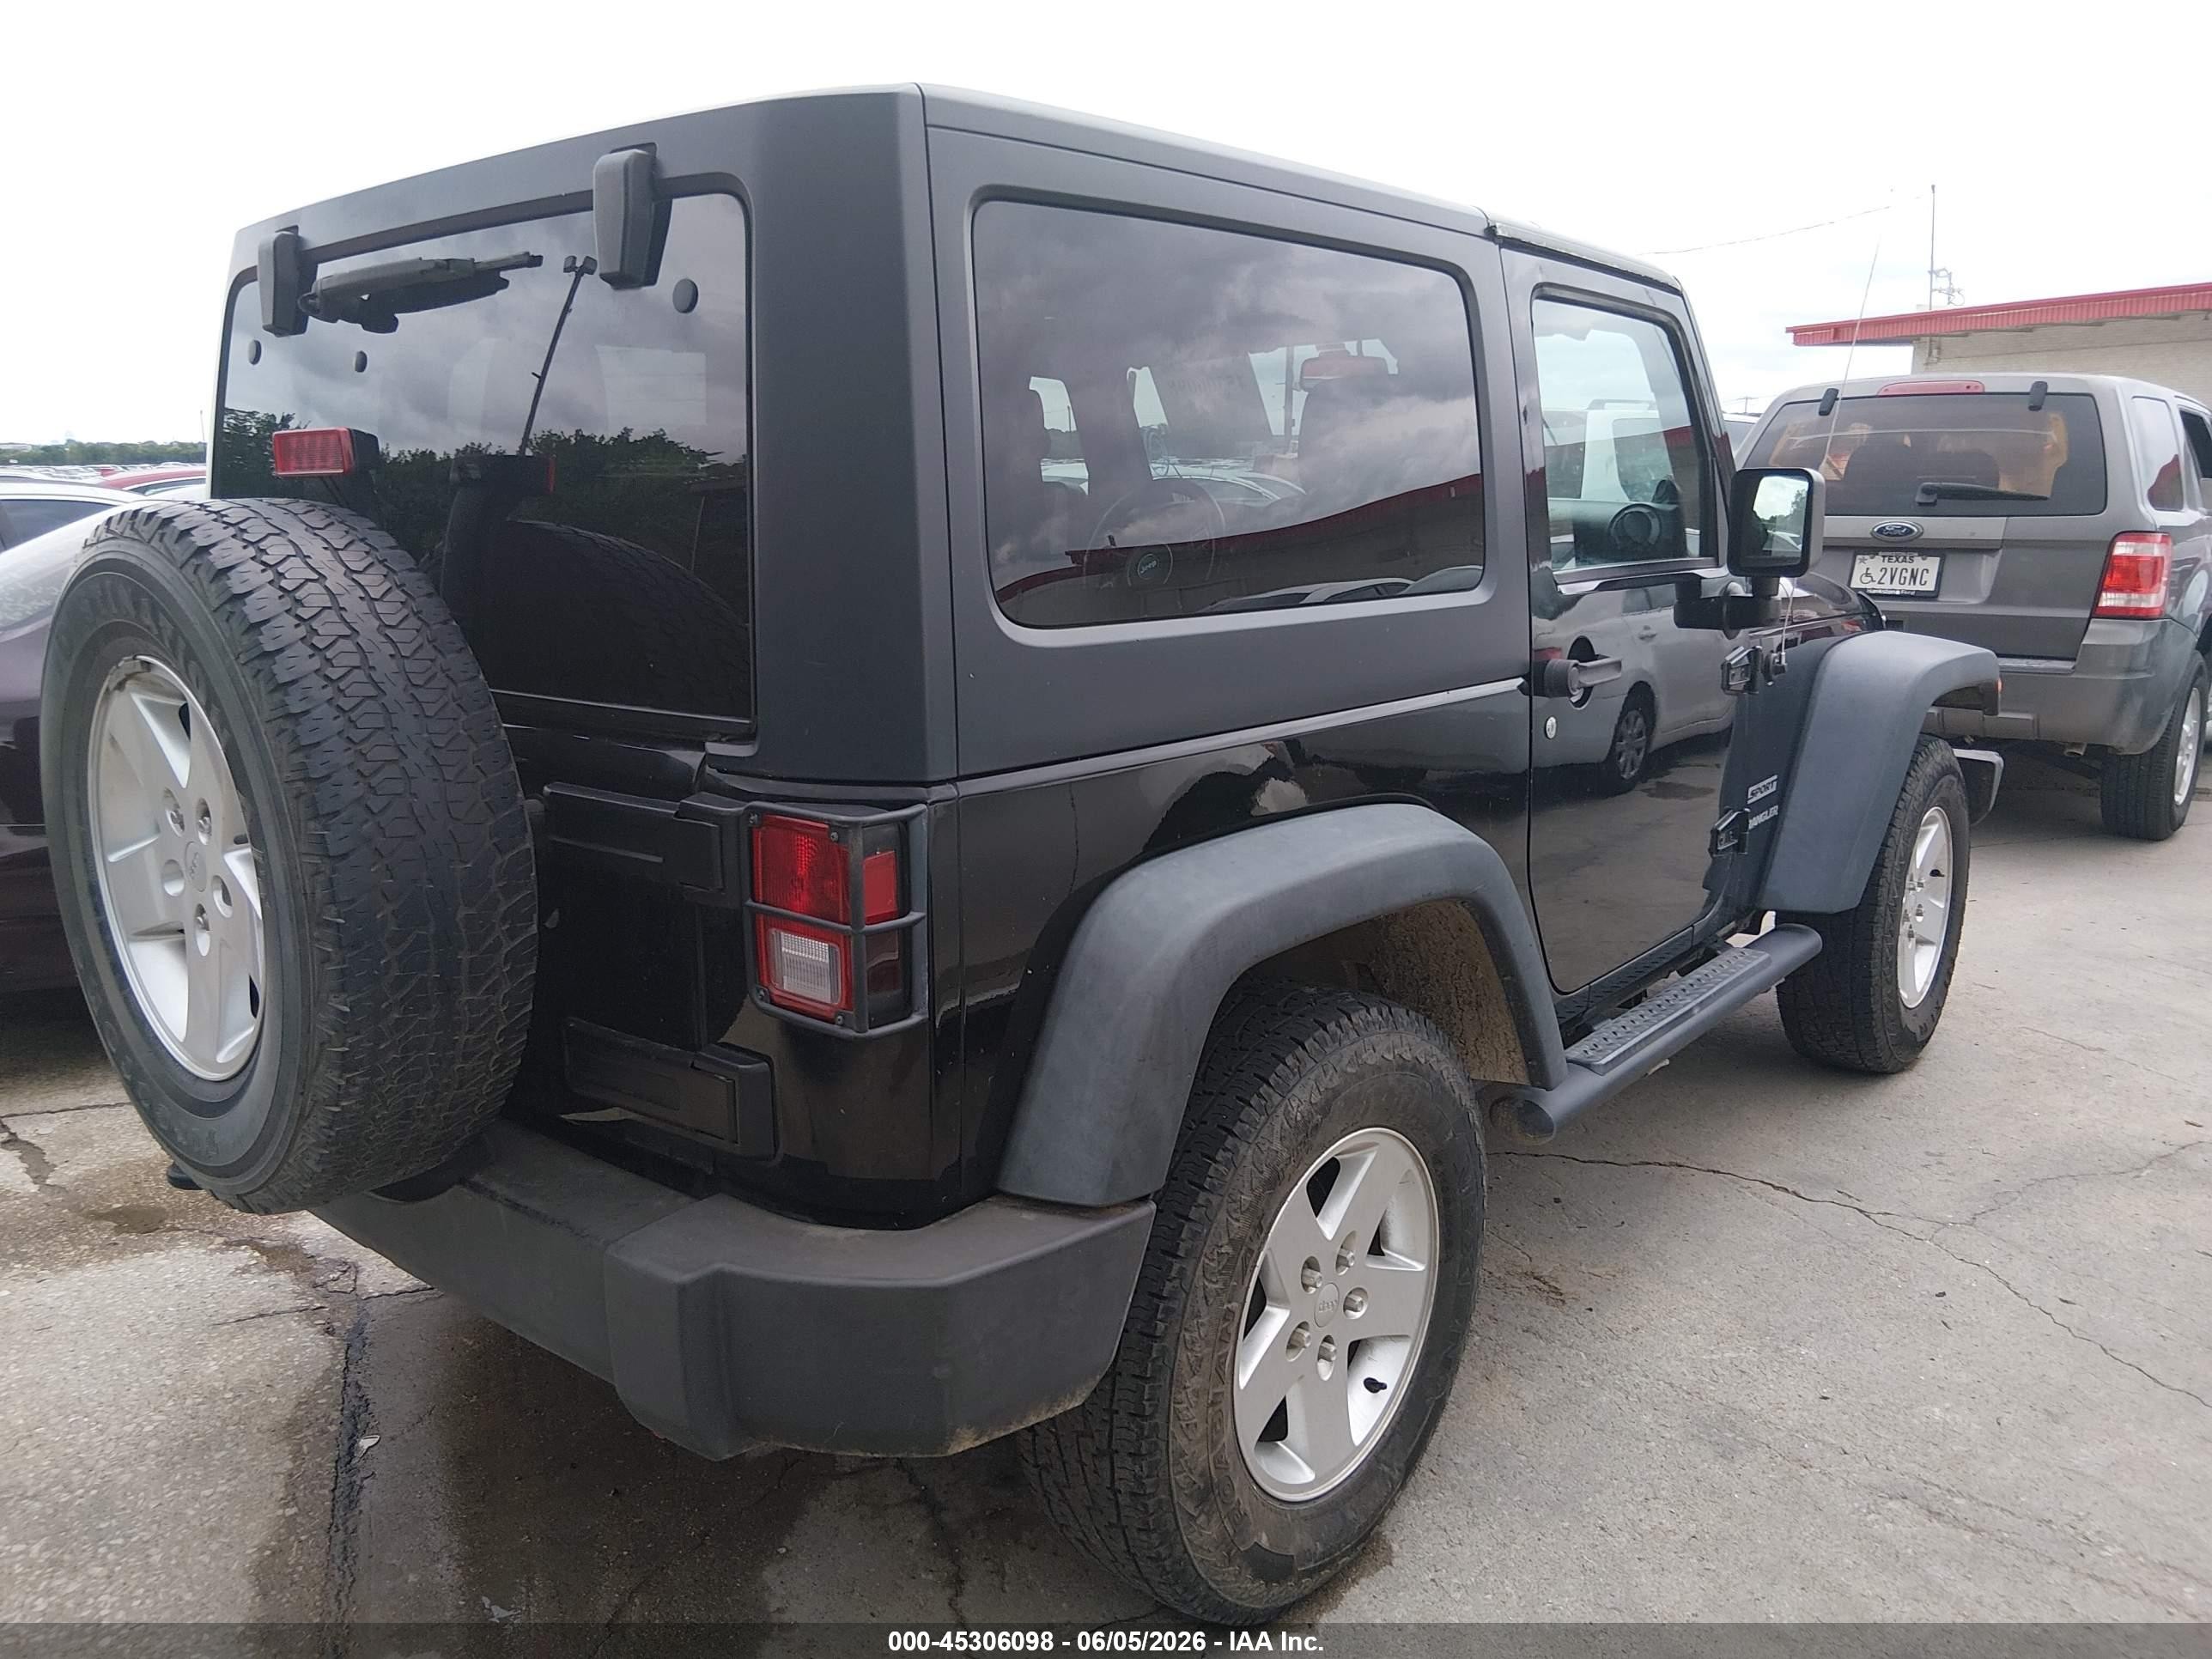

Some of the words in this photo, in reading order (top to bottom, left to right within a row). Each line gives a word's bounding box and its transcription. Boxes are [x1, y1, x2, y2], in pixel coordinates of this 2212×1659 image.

[1881, 555, 1914, 564] TEXAS
[1877, 567, 1929, 586] 2VGNC
[1748, 776, 1778, 799] SPORT
